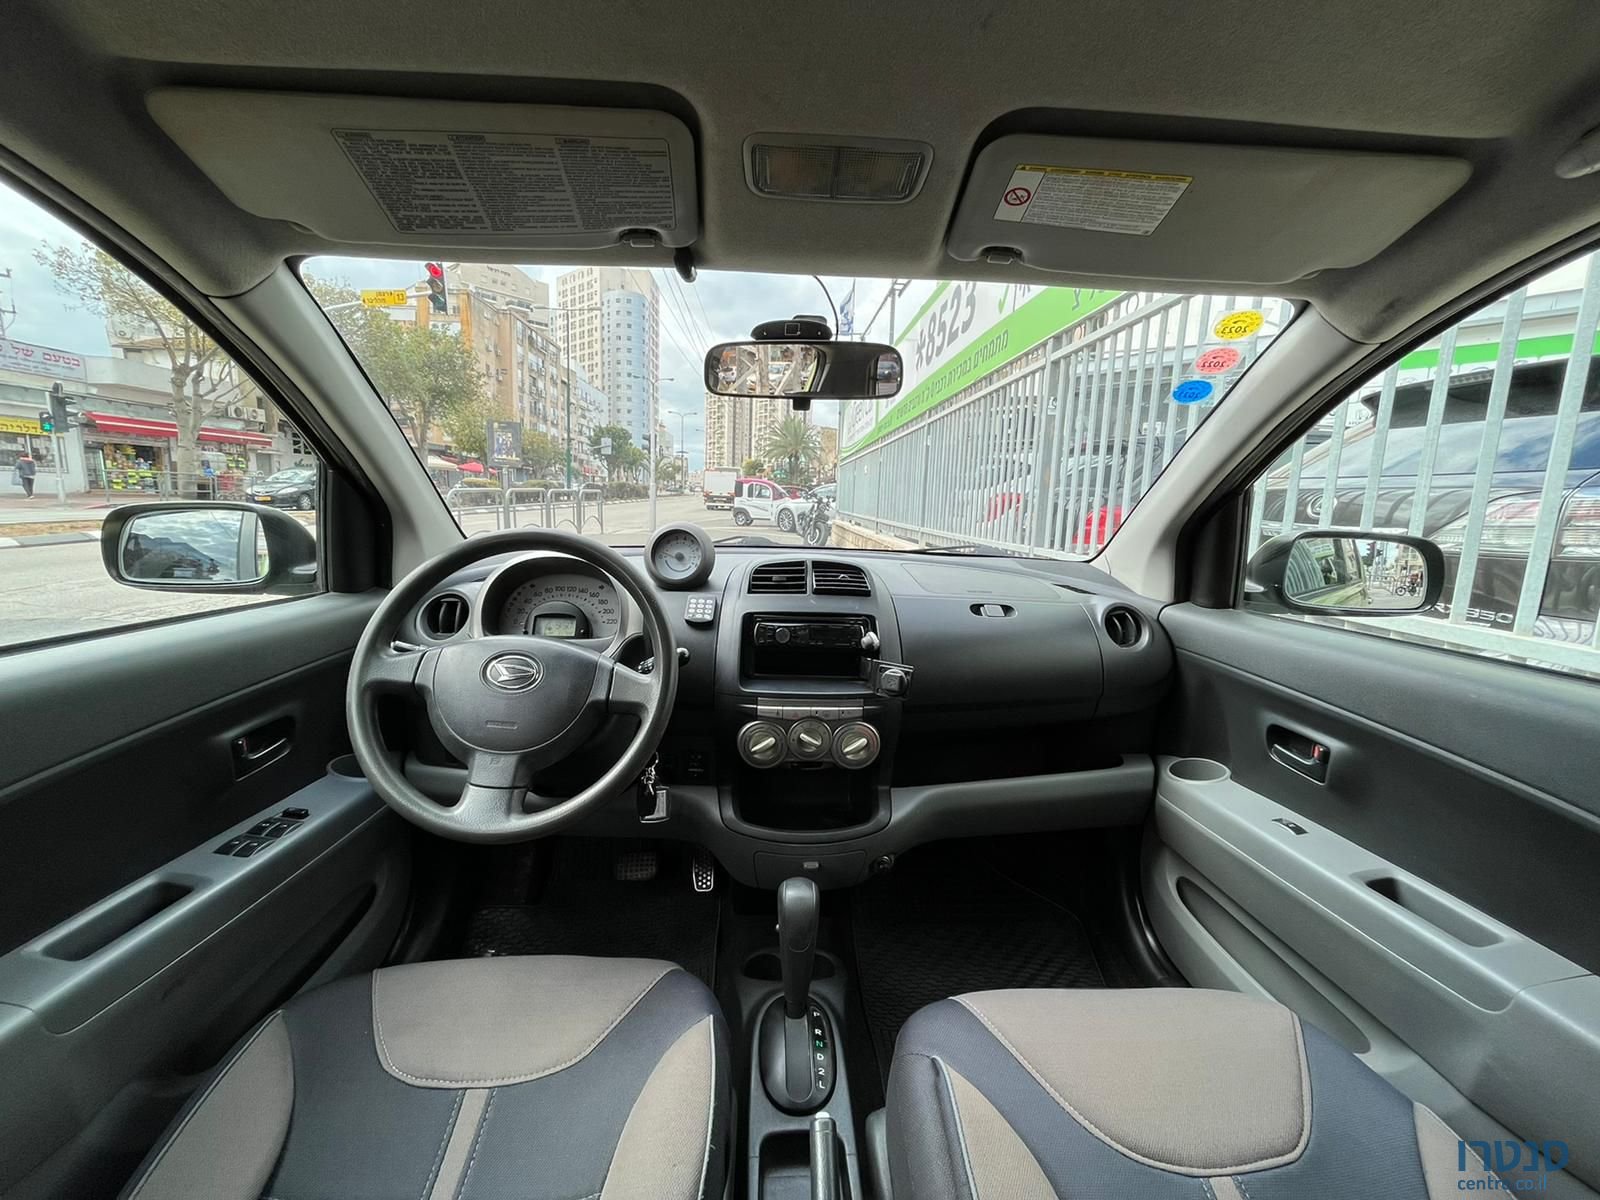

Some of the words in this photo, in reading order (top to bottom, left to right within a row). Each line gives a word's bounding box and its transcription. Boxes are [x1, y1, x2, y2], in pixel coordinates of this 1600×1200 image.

[396, 293, 404, 301] 13
[10, 343, 34, 357] של
[974, 329, 1009, 368] מתמחים
[42, 352, 81, 367] בטעם
[1466, 607, 1513, 623] 350
[818, 1068, 825, 1076] 2
[819, 1081, 826, 1089] L
